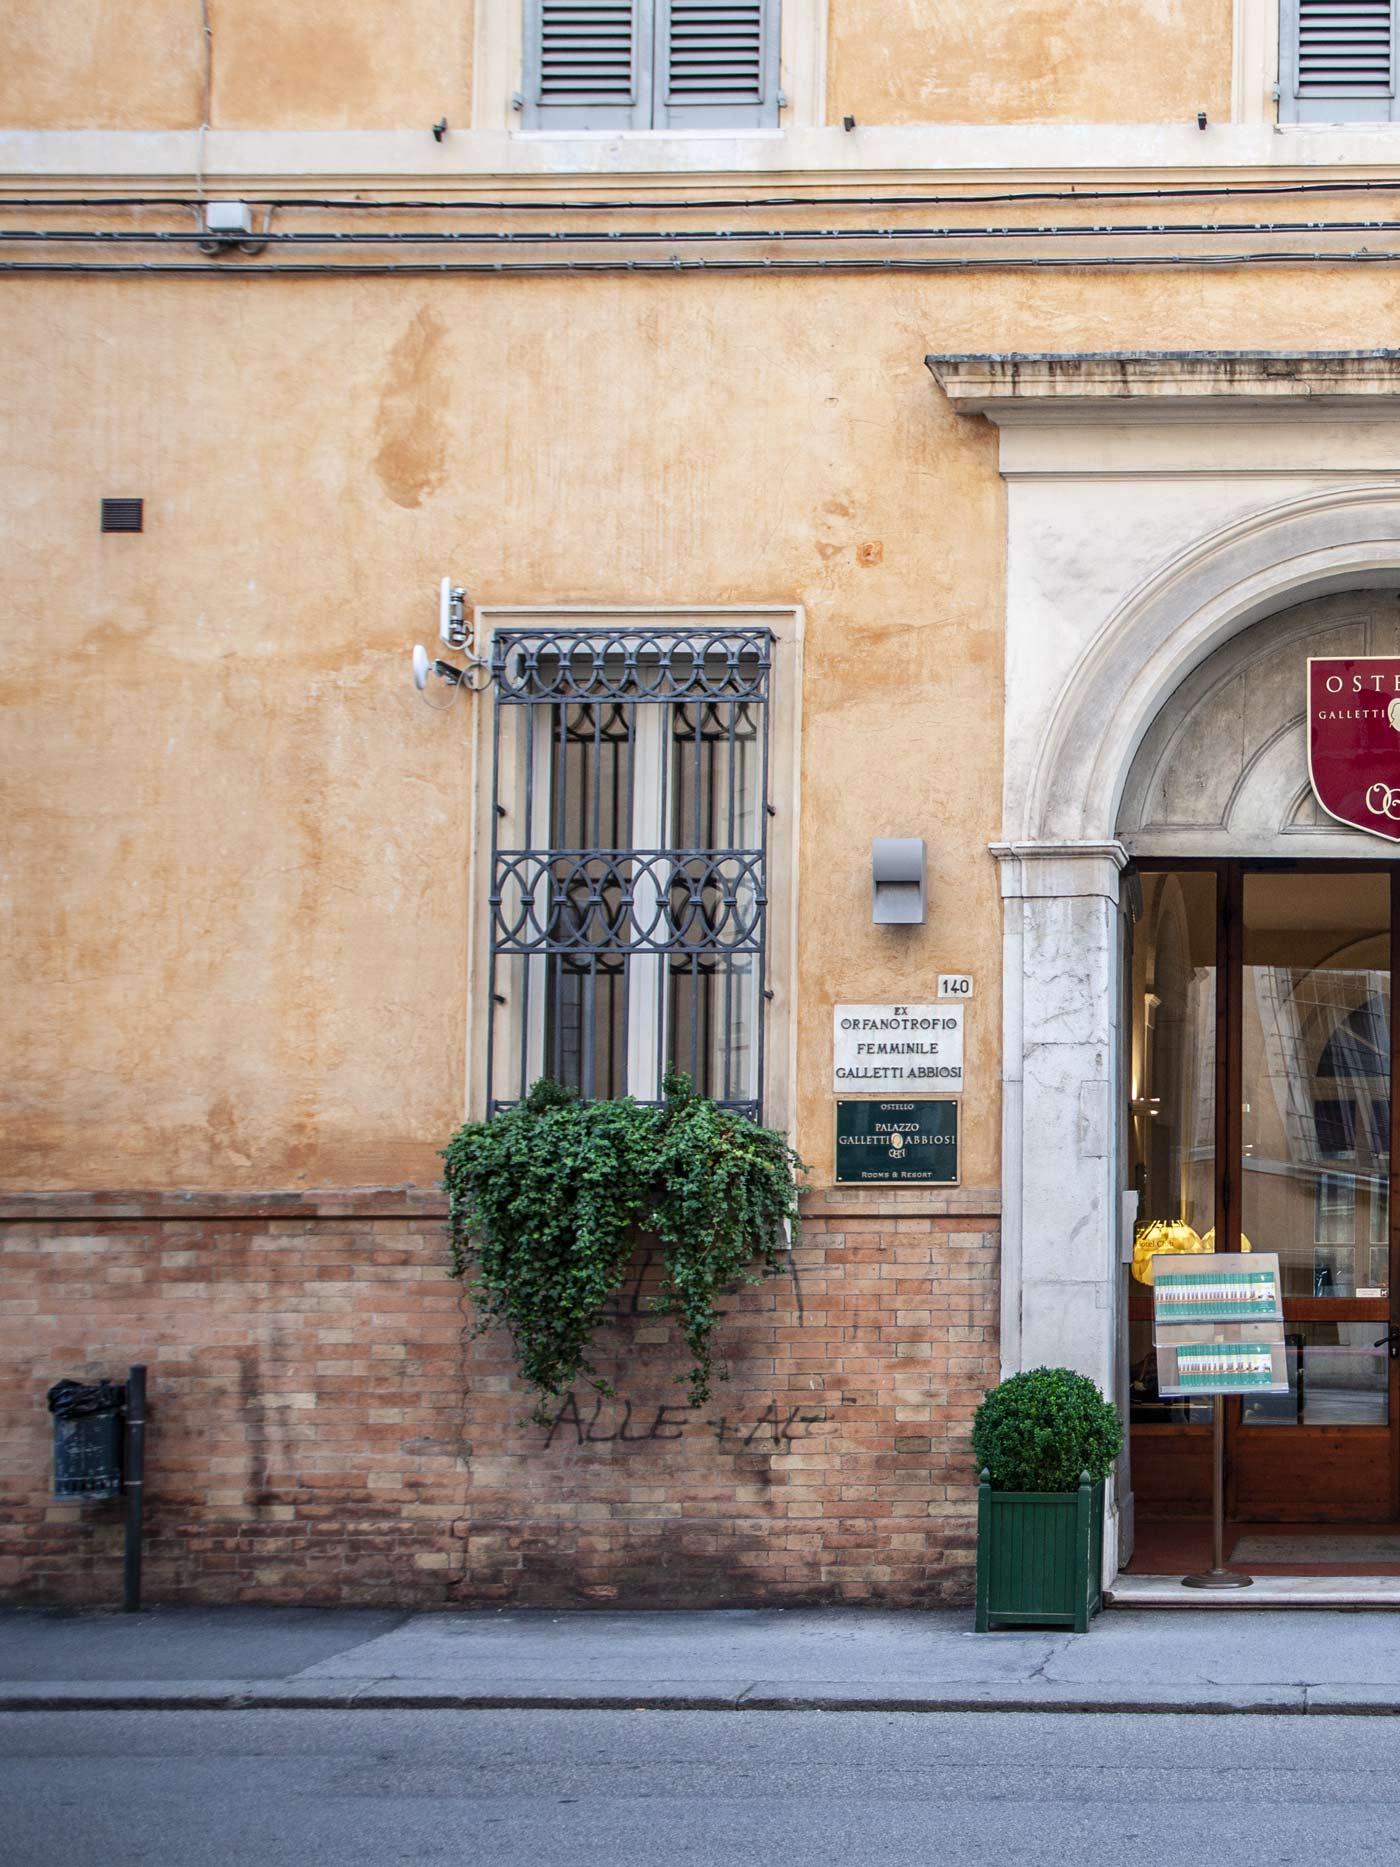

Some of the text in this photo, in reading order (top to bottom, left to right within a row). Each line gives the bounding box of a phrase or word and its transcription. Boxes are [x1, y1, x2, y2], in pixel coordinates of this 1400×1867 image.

[1318, 709, 1385, 720] GALLETTI
[943, 979, 970, 994] 140
[894, 1007, 908, 1016] EX
[840, 1018, 958, 1030] ORFANOTROFIO
[857, 1043, 939, 1055] FEMMINILE
[835, 1066, 962, 1079] GALLETTI ABBIOSI
[875, 1123, 919, 1132] PALAZZO
[838, 1135, 955, 1145] GALLETTI ABBIOSI
